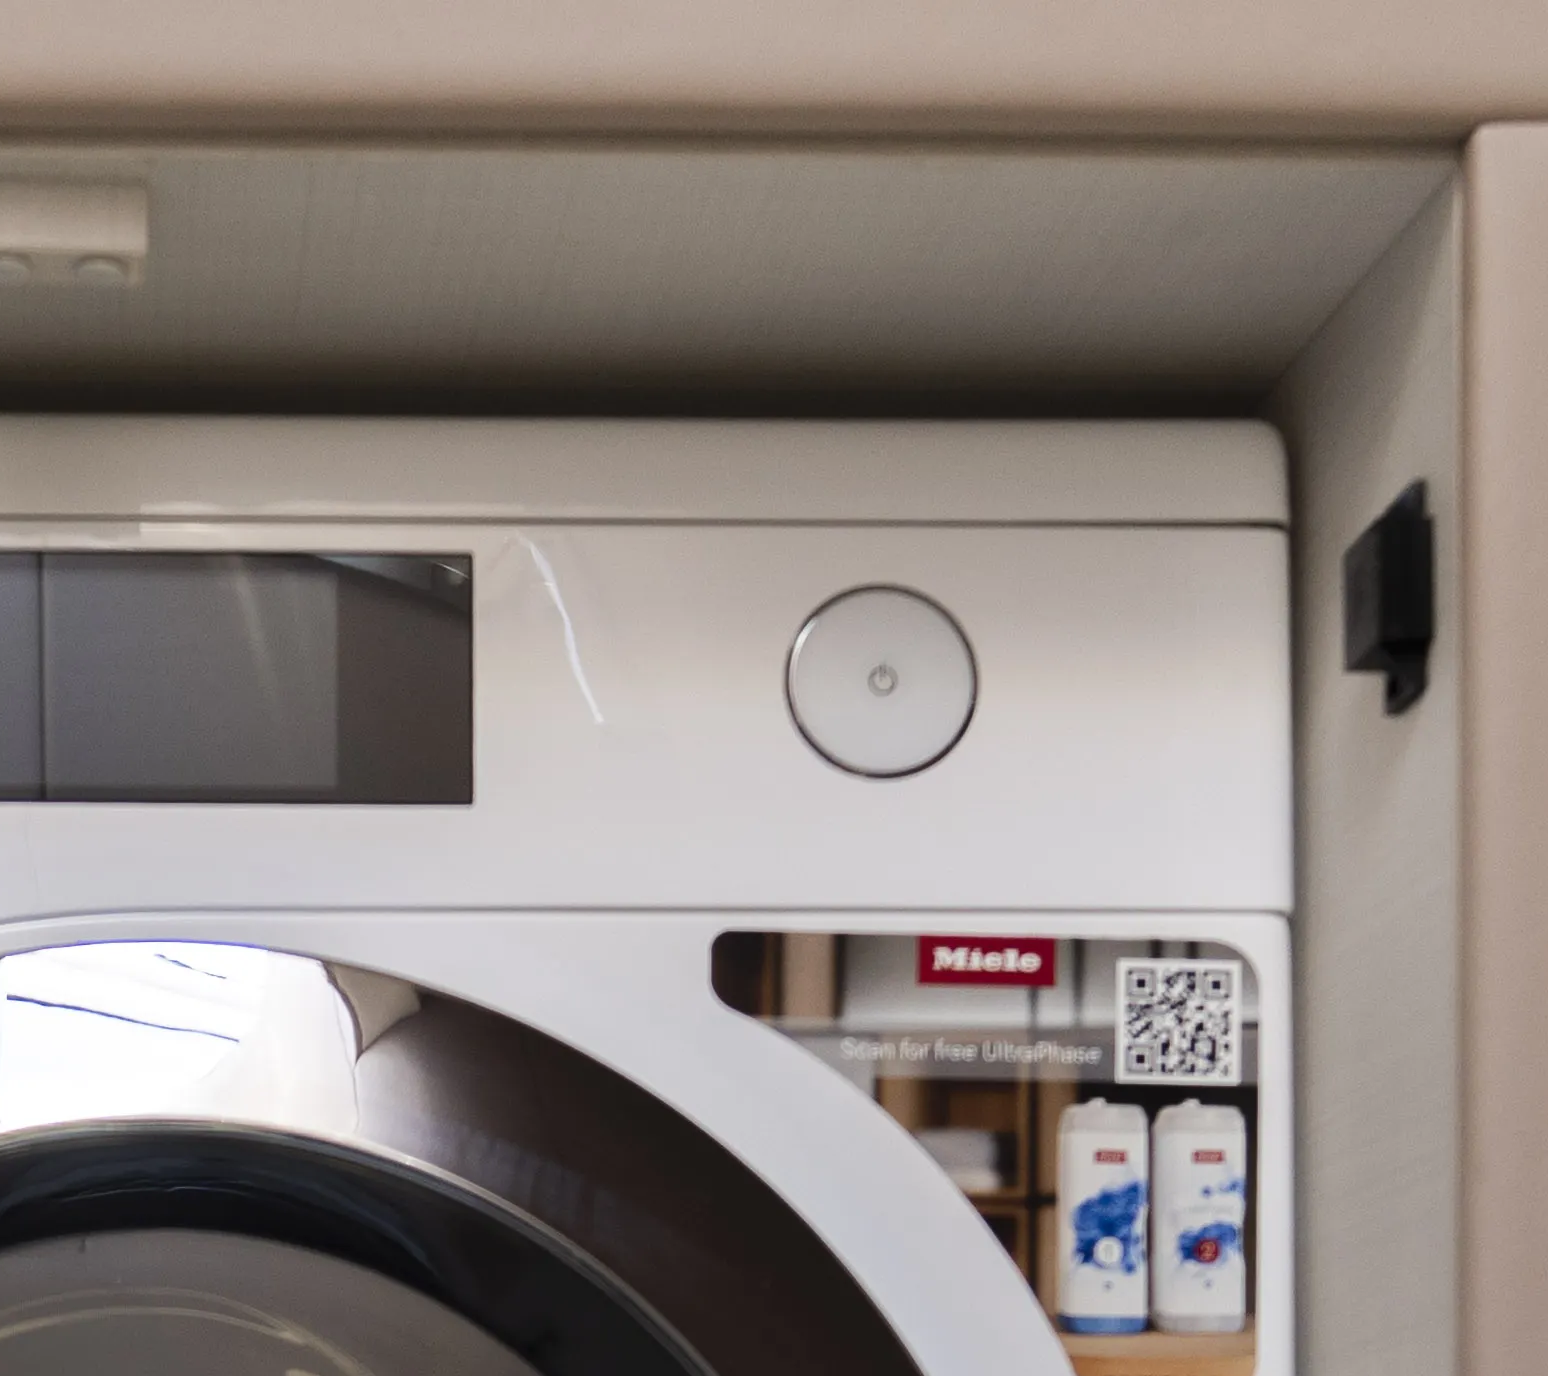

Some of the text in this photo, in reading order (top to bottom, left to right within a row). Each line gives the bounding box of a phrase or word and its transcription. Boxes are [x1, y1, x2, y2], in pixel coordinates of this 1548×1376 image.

[932, 946, 1042, 973] Miele
[840, 1036, 1103, 1065] Scan for free UltraPhase
[1200, 1241, 1216, 1260] 2
